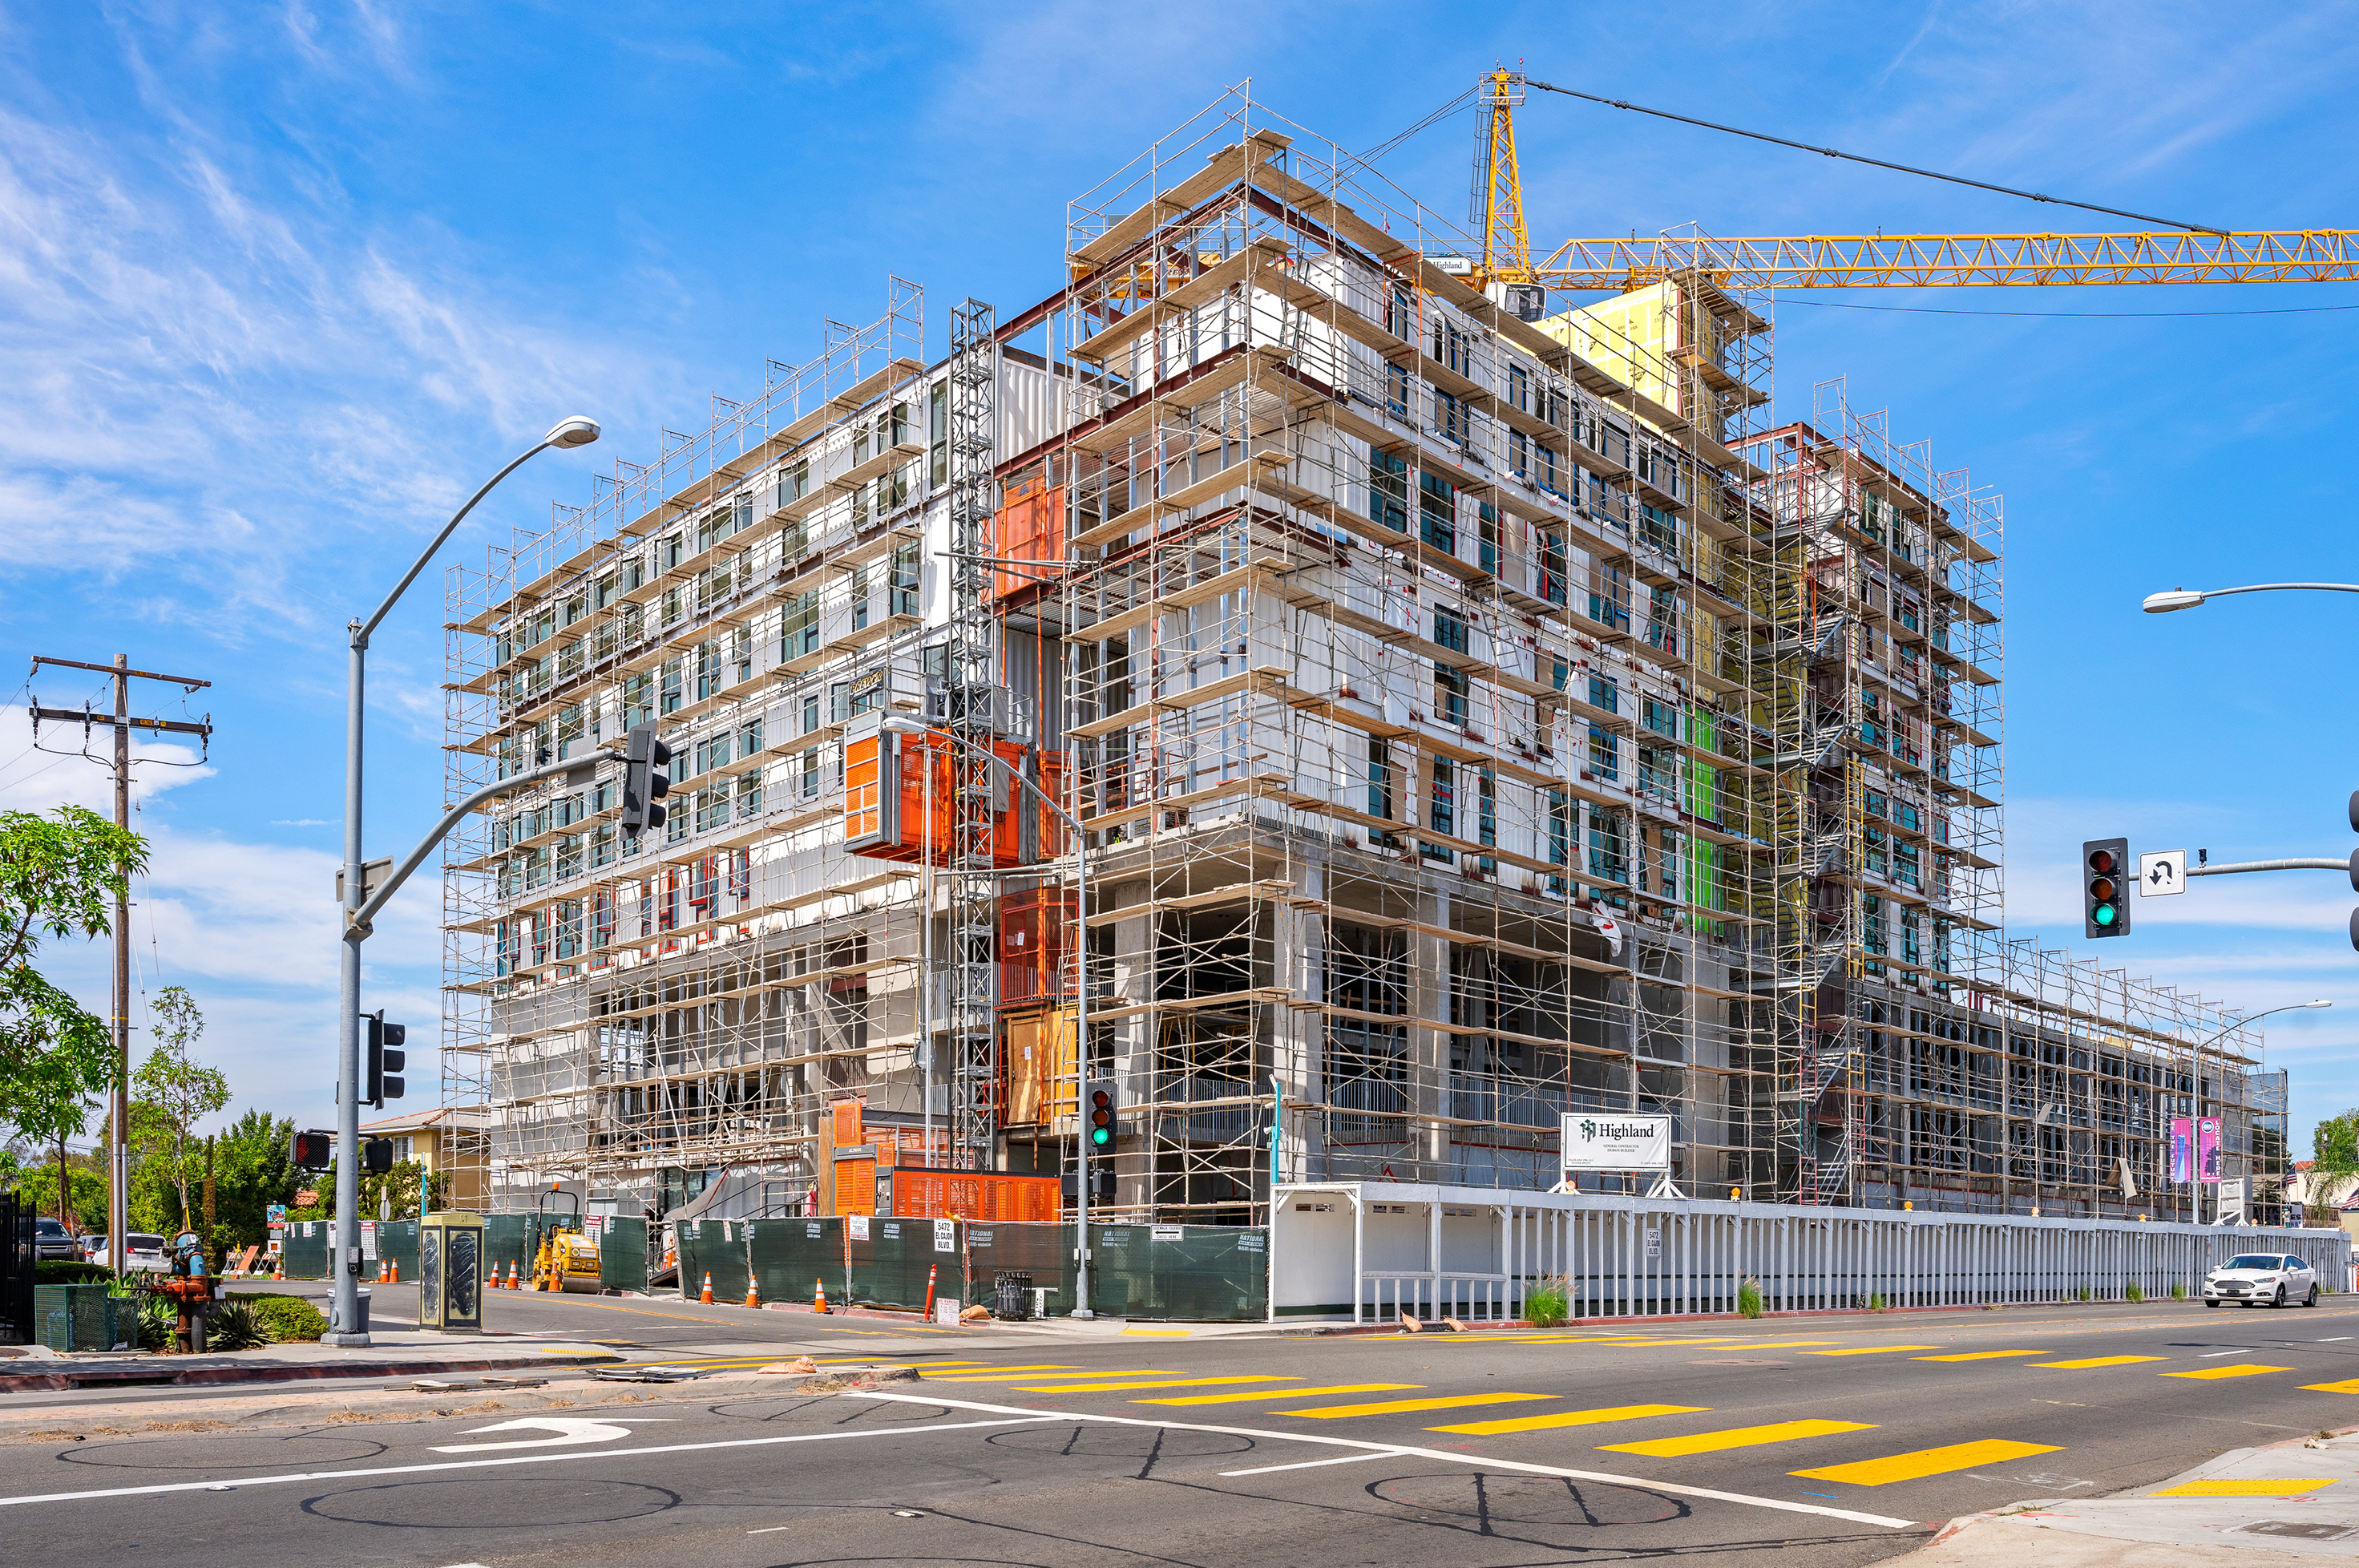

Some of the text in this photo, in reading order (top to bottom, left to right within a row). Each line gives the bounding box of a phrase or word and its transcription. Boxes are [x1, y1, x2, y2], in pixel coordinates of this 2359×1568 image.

[1433, 261, 1463, 270] Highland
[1599, 1123, 1654, 1141] Highland
[938, 1222, 950, 1231] 5472
[940, 1232, 953, 1240] CAJON
[1239, 1235, 1265, 1243] NATIONAL
[1649, 1231, 1658, 1239] 5472
[938, 1241, 951, 1249] BLVD.
